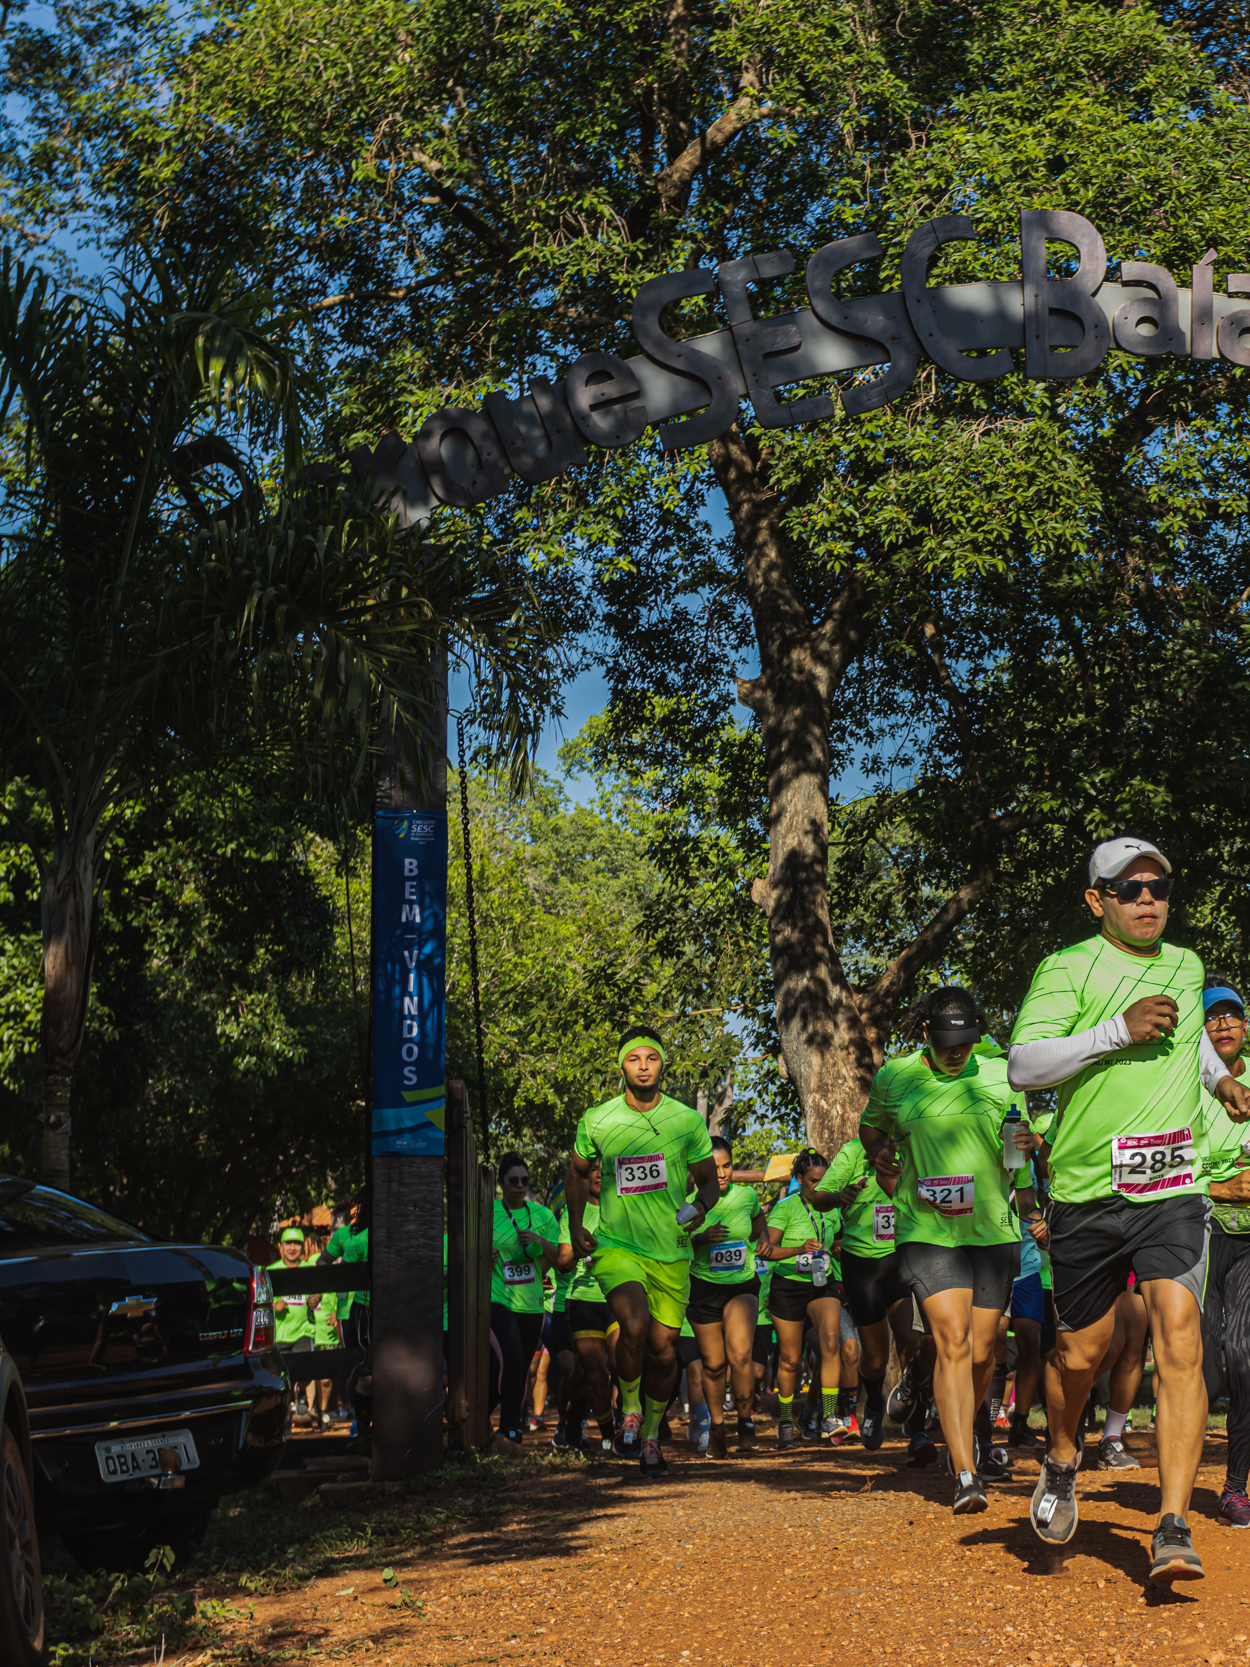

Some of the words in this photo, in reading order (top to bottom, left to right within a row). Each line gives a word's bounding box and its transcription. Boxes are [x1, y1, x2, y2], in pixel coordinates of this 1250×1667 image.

[632, 213, 1014, 451] SESC
[411, 824, 435, 833] SESC
[1127, 1146, 1186, 1175] 285
[624, 1163, 661, 1182] 336
[924, 1186, 965, 1204] 321
[715, 1249, 742, 1263] 039
[507, 1264, 531, 1278] 399
